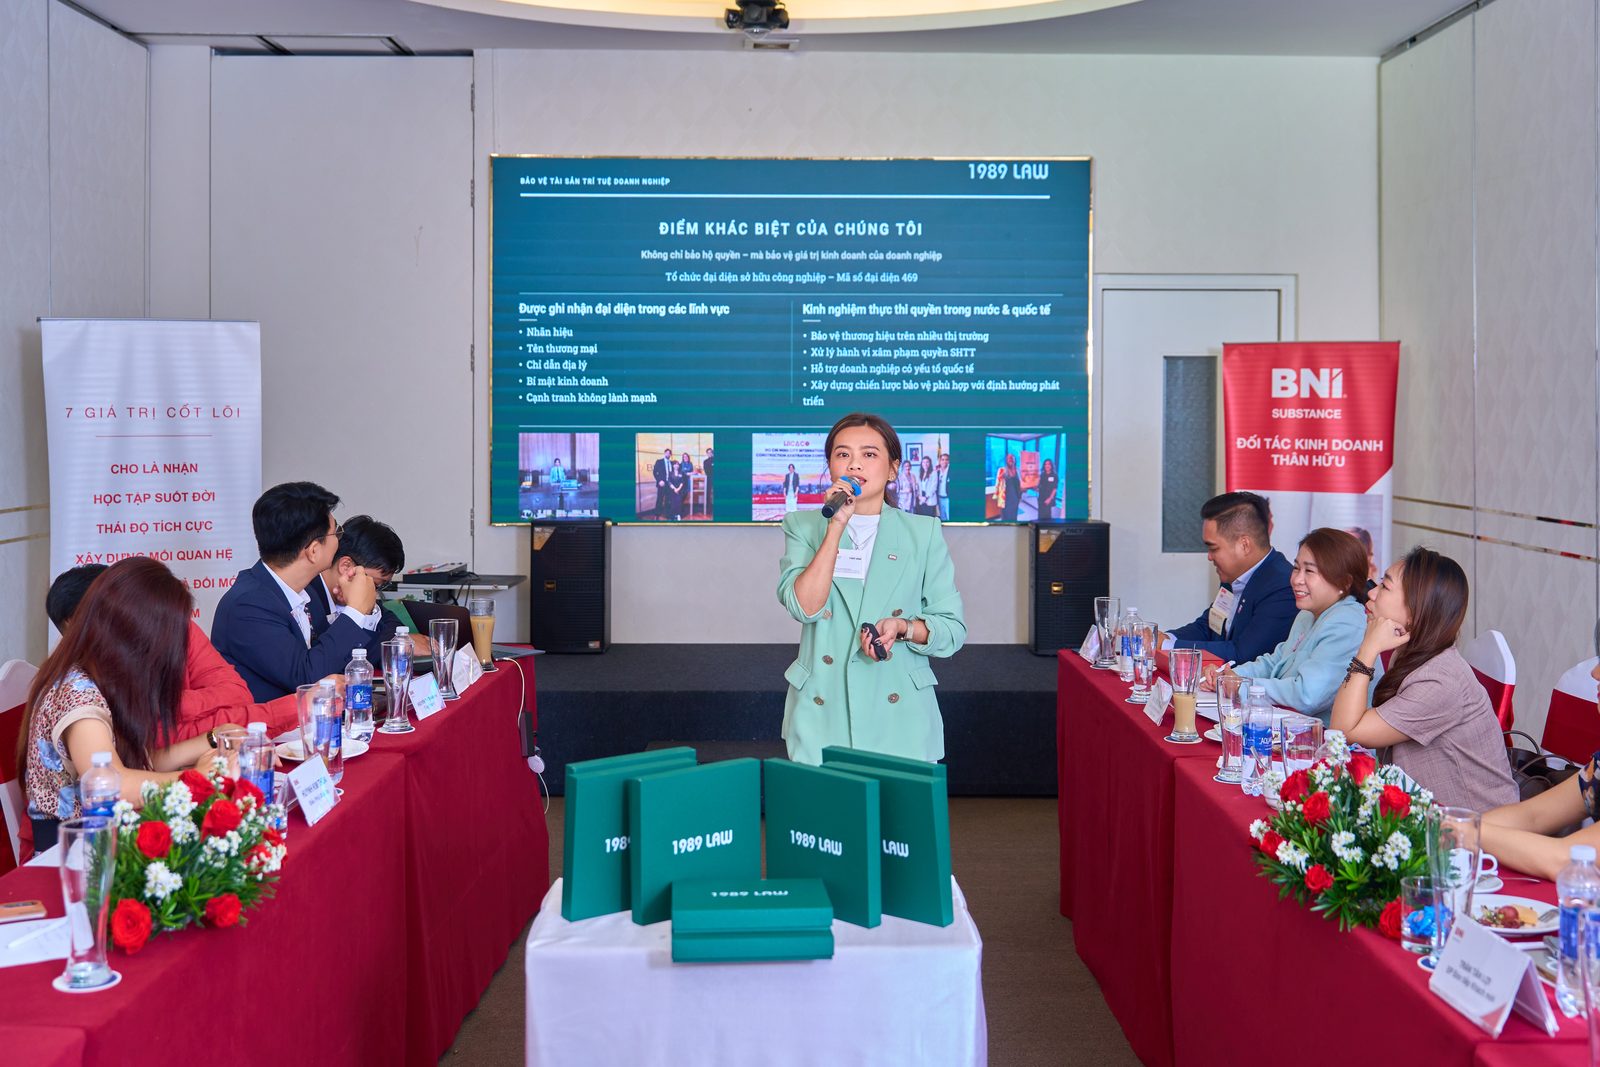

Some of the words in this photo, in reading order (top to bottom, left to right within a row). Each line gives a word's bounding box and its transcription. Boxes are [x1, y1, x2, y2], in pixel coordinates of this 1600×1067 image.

[968, 163, 1008, 180] 1989
[1013, 163, 1049, 180] LAW
[520, 176, 536, 184] BẢO
[537, 177, 548, 185] VỆ
[564, 176, 580, 185] SẢN
[582, 177, 595, 185] TRÍ
[596, 177, 612, 186] TUỆ
[641, 177, 671, 186] NGHIỆP
[658, 219, 698, 235] ĐIỂM
[705, 220, 748, 235] KHÁC
[754, 220, 790, 238] BIỆT
[796, 219, 828, 235] CỦA
[834, 220, 889, 235] CHÚNG
[895, 220, 922, 236] TÔI
[641, 250, 668, 261] Không
[670, 250, 683, 259] chỉ
[684, 249, 701, 259] bảo
[702, 250, 713, 261] hộ
[715, 250, 740, 261] quyền
[750, 251, 764, 259] mà
[765, 250, 782, 259] bảo
[783, 251, 793, 261] vệ
[794, 251, 808, 261] giá
[810, 251, 819, 261] trị
[821, 251, 839, 259] kinh
[840, 251, 867, 260] doanh
[868, 250, 884, 260] của
[886, 251, 912, 260] doanh
[913, 251, 942, 262] nghiệp
[665, 271, 678, 281] Tổ
[679, 272, 701, 281] chức
[702, 272, 717, 283] đại
[718, 272, 738, 283] diện
[740, 272, 751, 281] sở
[752, 272, 771, 282] hữu
[772, 272, 794, 284] công
[795, 272, 826, 284] nghiệp
[836, 273, 851, 282] Mã
[852, 272, 863, 282] số
[864, 272, 879, 284] đại
[880, 273, 900, 283] diện
[901, 273, 918, 282] 469
[519, 303, 546, 315] Được
[548, 303, 565, 316] ghi
[567, 303, 593, 316] nhận
[595, 303, 611, 316] đại
[613, 303, 636, 316] diện
[638, 304, 666, 316] trong
[668, 303, 687, 314] các
[689, 303, 708, 314] lĩnh
[710, 306, 730, 316] vực
[802, 303, 826, 314] Kinh
[828, 303, 866, 317] nghiệm
[868, 304, 892, 317] thực
[894, 304, 908, 315] thi
[910, 303, 942, 317] quyền
[943, 305, 972, 317] trong
[974, 304, 1000, 315] nước
[1002, 304, 1010, 315] &
[1012, 304, 1038, 317] quốc
[1039, 304, 1051, 315] tế
[527, 327, 551, 337] Nhãn
[553, 327, 573, 338] hiệu
[810, 331, 828, 340] Bảo
[829, 331, 840, 342] vệ
[842, 331, 874, 342] thương
[875, 331, 895, 342] hiệu
[896, 331, 916, 340] trên
[917, 331, 943, 341] nhiều
[944, 331, 957, 342] thị
[958, 331, 989, 343] trường
[526, 344, 544, 353] Tên
[546, 344, 578, 355] thương
[580, 344, 598, 355] mại
[811, 347, 824, 357] Xử
[826, 347, 835, 359] lý
[836, 347, 860, 357] hành
[861, 348, 870, 357] vi
[872, 348, 892, 357] xâm
[893, 347, 920, 359] phạm
[921, 347, 949, 359] quyền
[950, 348, 976, 357] SHTT
[526, 360, 542, 369] Chỉ
[543, 359, 560, 369] dẫn
[562, 360, 576, 371] địa
[578, 360, 588, 371] lý
[810, 363, 824, 373] Hỗ
[825, 365, 838, 374] trợ
[839, 364, 868, 373] doanh
[869, 364, 900, 375] nghiệp
[902, 364, 912, 373] có
[914, 363, 930, 375] yếu
[932, 363, 941, 373] tố
[942, 363, 964, 375] quốc
[965, 363, 974, 373] tế
[526, 376, 536, 386] Bí
[538, 377, 556, 387] mật
[557, 376, 579, 386] kinh
[580, 376, 609, 386] doanh
[810, 380, 829, 391] Xây
[830, 380, 854, 391] dựng
[854, 379, 880, 390] chiến
[881, 380, 902, 391] lược
[902, 380, 920, 389] bảo
[920, 380, 932, 391] vệ
[932, 380, 951, 391] phù
[951, 380, 970, 392] hợp
[970, 380, 986, 390] với
[986, 380, 1008, 391] định
[1008, 380, 1038, 392] hướng
[1039, 380, 1060, 392] phát
[1272, 368, 1343, 399] BNI
[526, 393, 550, 404] Cạnh
[552, 393, 576, 402] tranh
[578, 393, 607, 404] không
[608, 393, 629, 402] lành
[630, 393, 657, 404] mạnh
[802, 395, 825, 406] triển
[65, 408, 74, 418] 7
[84, 405, 117, 418] GIÁ
[126, 407, 156, 419] TRỊ
[166, 404, 202, 418] CỐT
[212, 405, 240, 418] LÕI
[1272, 409, 1342, 419] SUBSTANCE
[1236, 434, 1261, 450] ĐỐI
[1264, 434, 1292, 450] TÁC
[1295, 438, 1328, 451] KINH
[1331, 439, 1383, 451] DOANH
[1271, 452, 1309, 466] THÂN
[1312, 452, 1346, 468] HỮU
[110, 464, 139, 474] CHO
[142, 462, 160, 473] LÀ
[163, 462, 198, 475] NHẬN
[94, 494, 122, 506] HỌC
[125, 493, 151, 505] TẬP
[154, 491, 189, 502] SUỐT
[192, 490, 215, 501] ĐỜI
[96, 521, 126, 534] THÁI
[129, 523, 149, 534] ĐỘ
[152, 520, 182, 532] TÍCH
[184, 521, 213, 533] CỰC
[76, 551, 103, 564] XÂY
[177, 550, 212, 561] QUAN
[216, 548, 233, 561] HỆ
[672, 836, 703, 855] 1989
[705, 829, 733, 848] LAW
[790, 830, 816, 849] 1989
[819, 837, 843, 856] LAW
[882, 839, 909, 857] LAW
